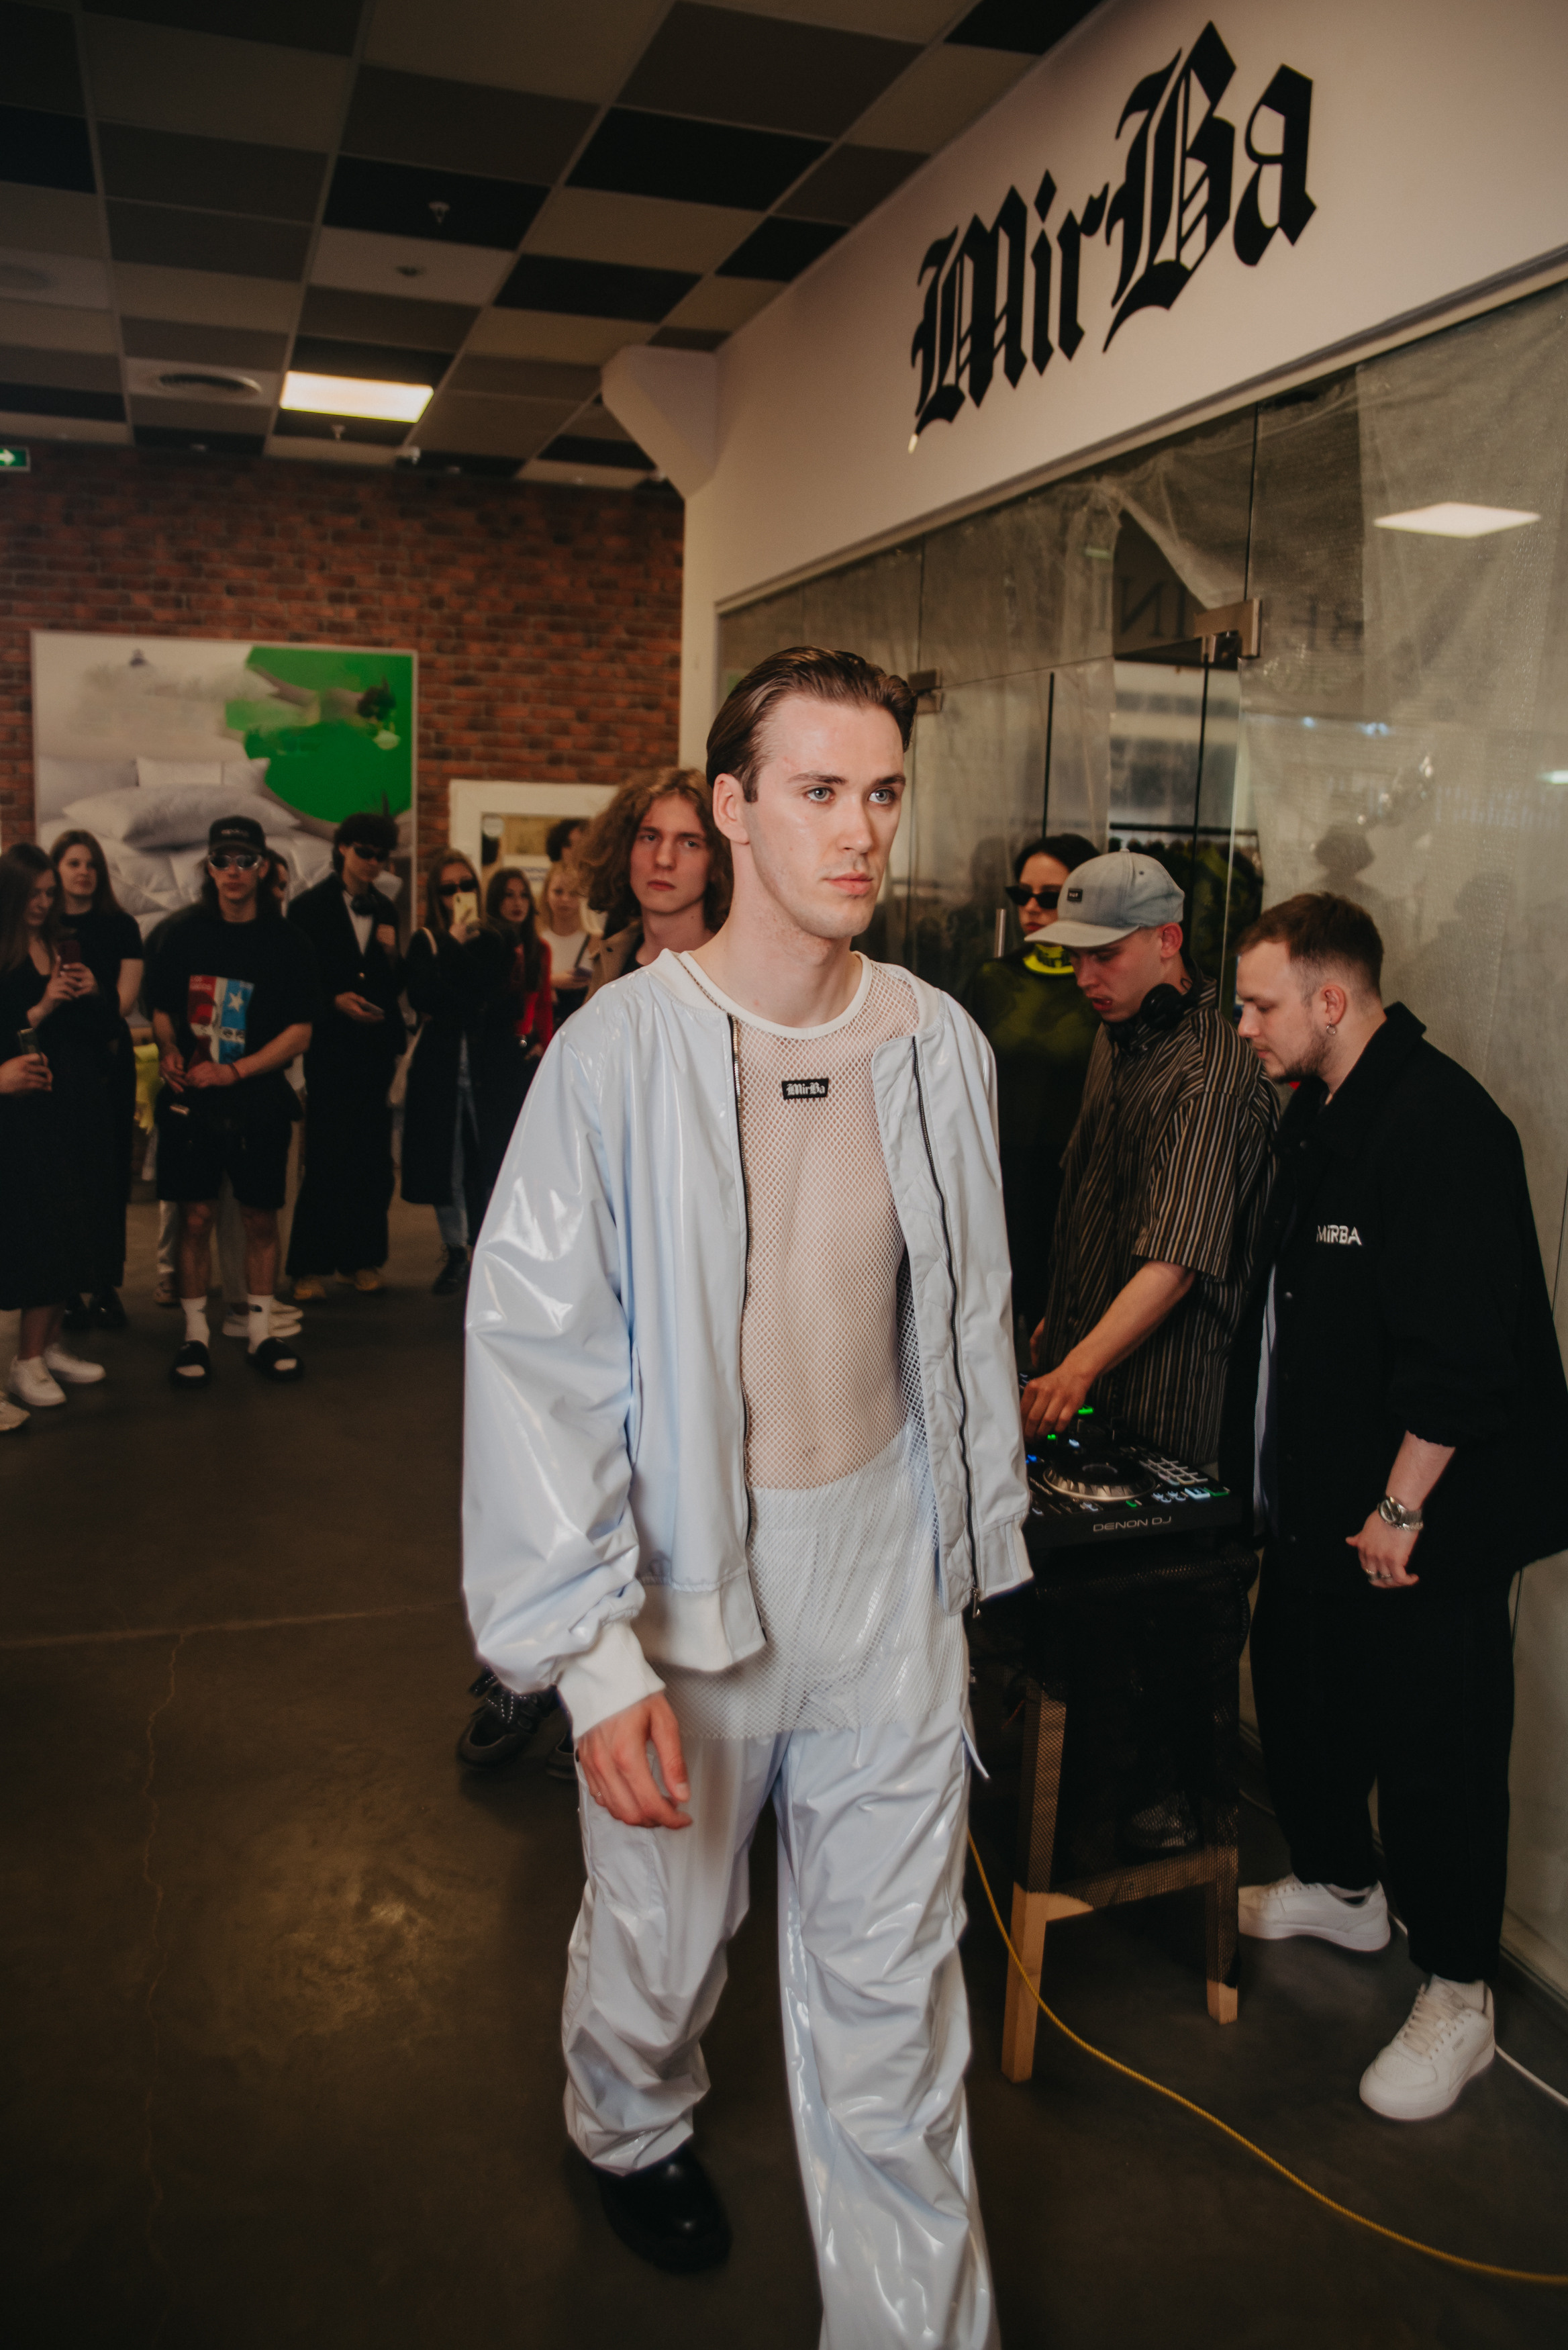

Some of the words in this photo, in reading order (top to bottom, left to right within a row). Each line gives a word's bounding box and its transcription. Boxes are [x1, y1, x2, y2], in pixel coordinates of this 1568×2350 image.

[911, 20, 1316, 436] MirBa
[786, 1082, 826, 1096] MirBa
[1093, 1518, 1148, 1532] DENON
[1152, 1515, 1171, 1525] DJ
